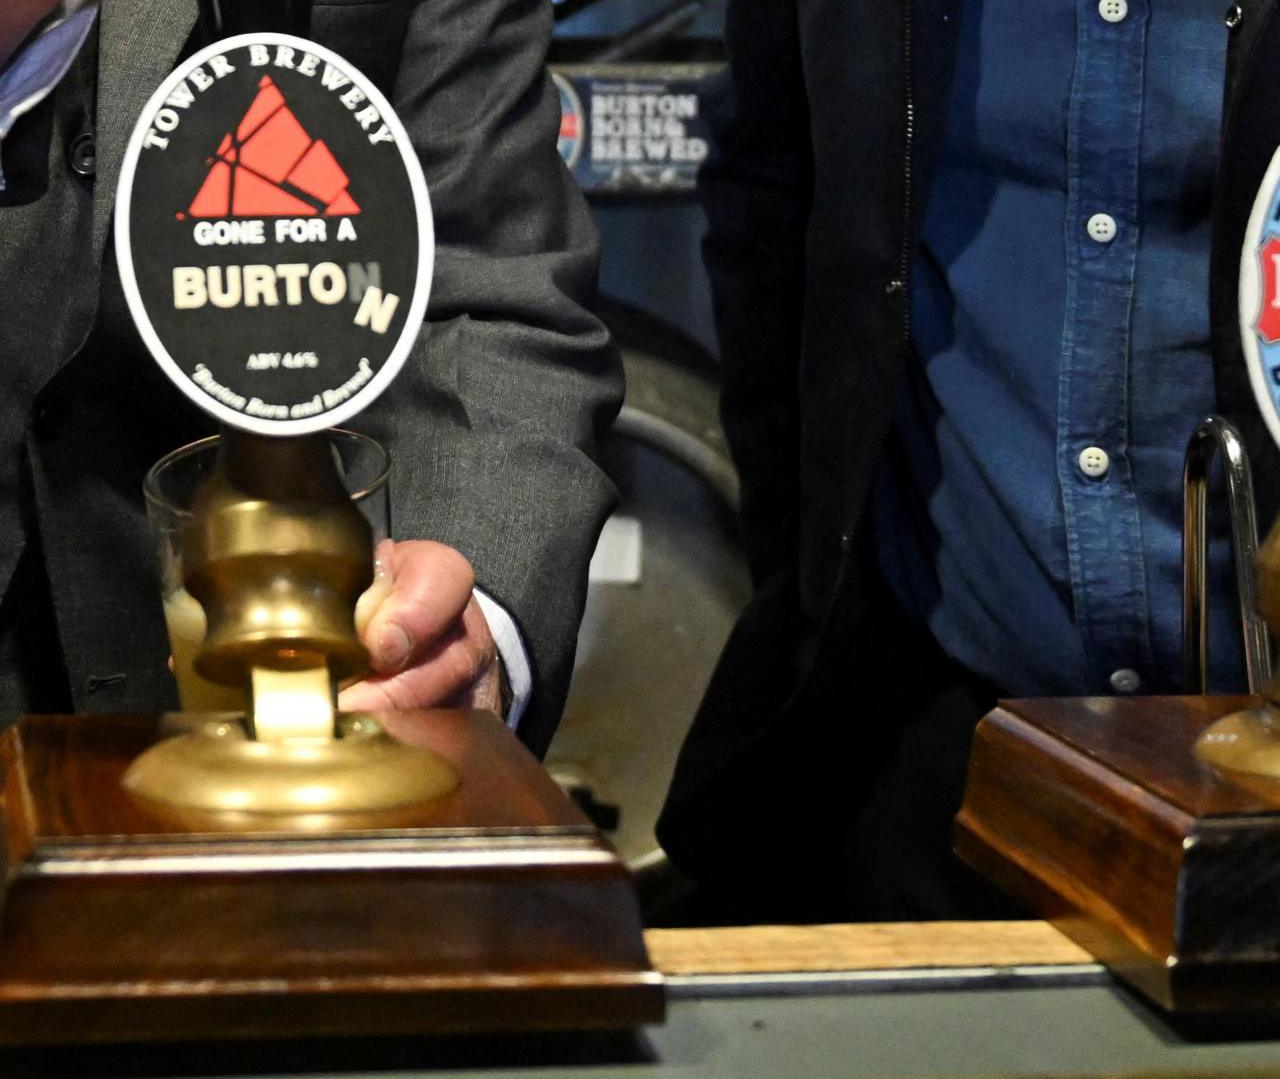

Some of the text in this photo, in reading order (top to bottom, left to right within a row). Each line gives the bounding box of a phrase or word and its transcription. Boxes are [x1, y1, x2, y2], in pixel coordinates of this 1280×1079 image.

[142, 43, 396, 152] TOWER BREWERY
[591, 94, 698, 118] BURTON
[591, 138, 709, 161] BREWED
[193, 218, 358, 246] GONE FOR A
